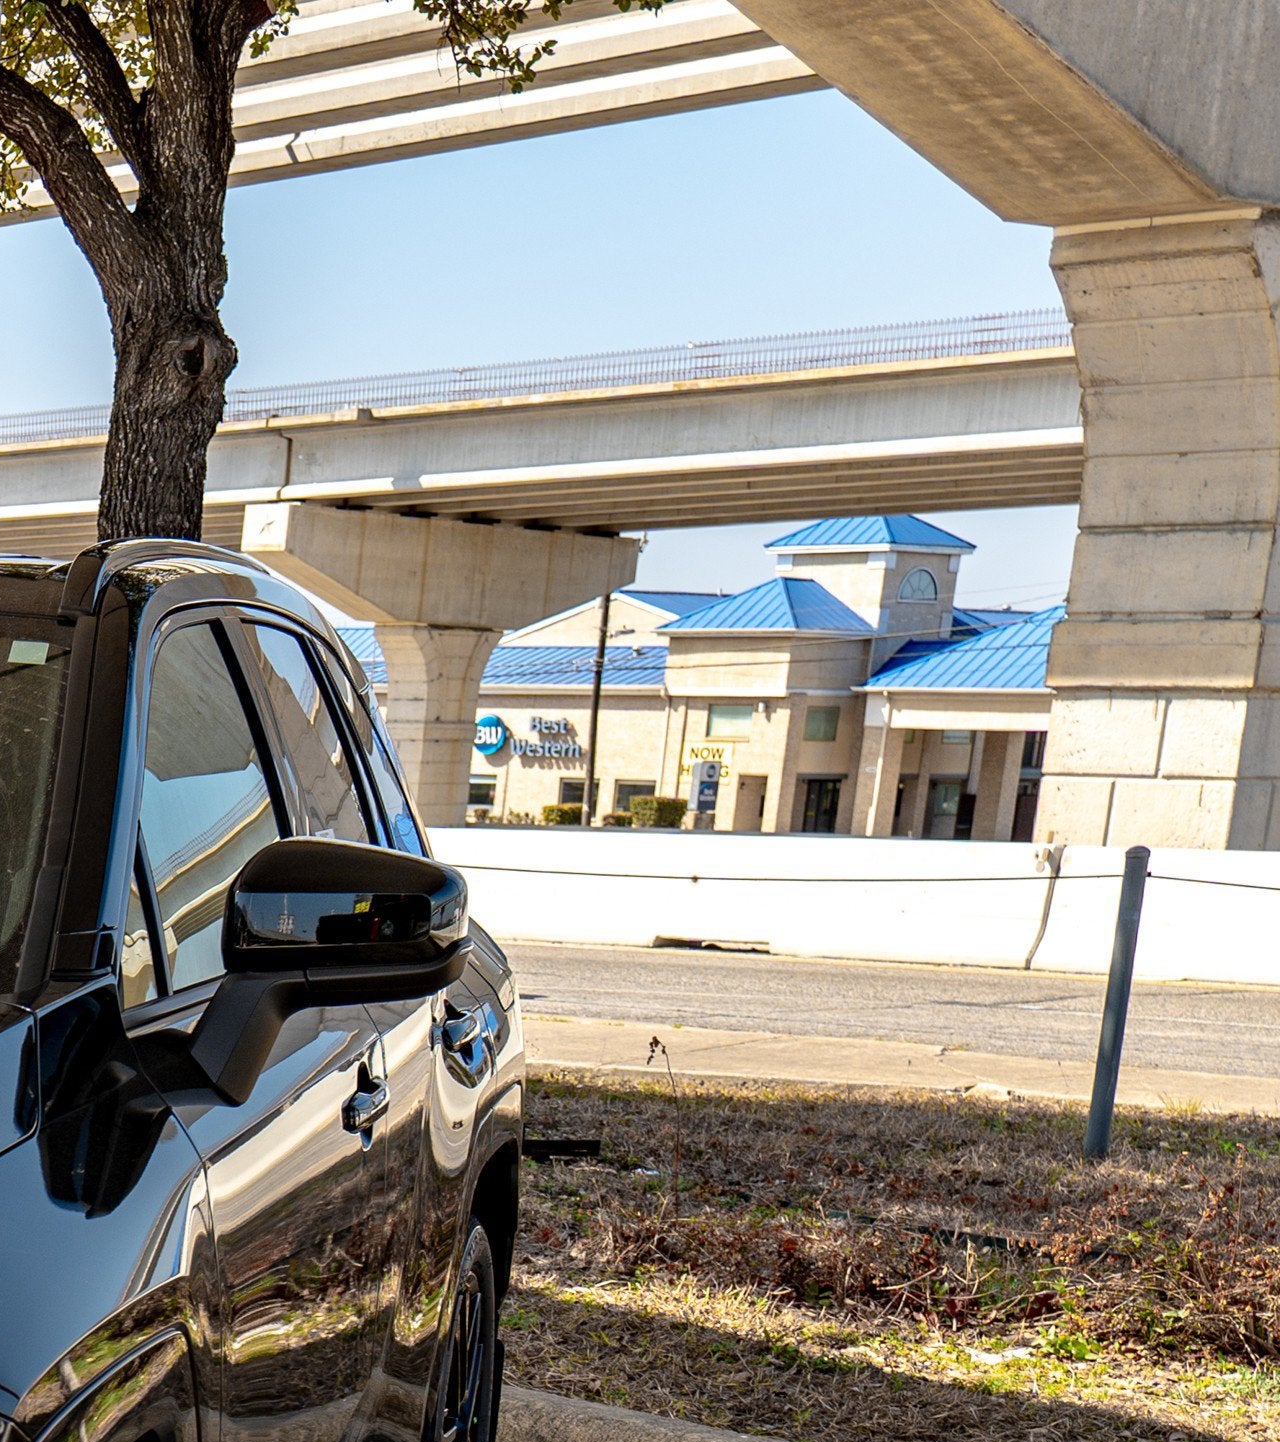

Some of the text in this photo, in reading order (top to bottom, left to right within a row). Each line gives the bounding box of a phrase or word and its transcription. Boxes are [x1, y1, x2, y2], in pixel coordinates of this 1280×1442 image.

[529, 715, 568, 733] Best
[510, 738, 582, 759] Western
[689, 746, 725, 760] NOW
